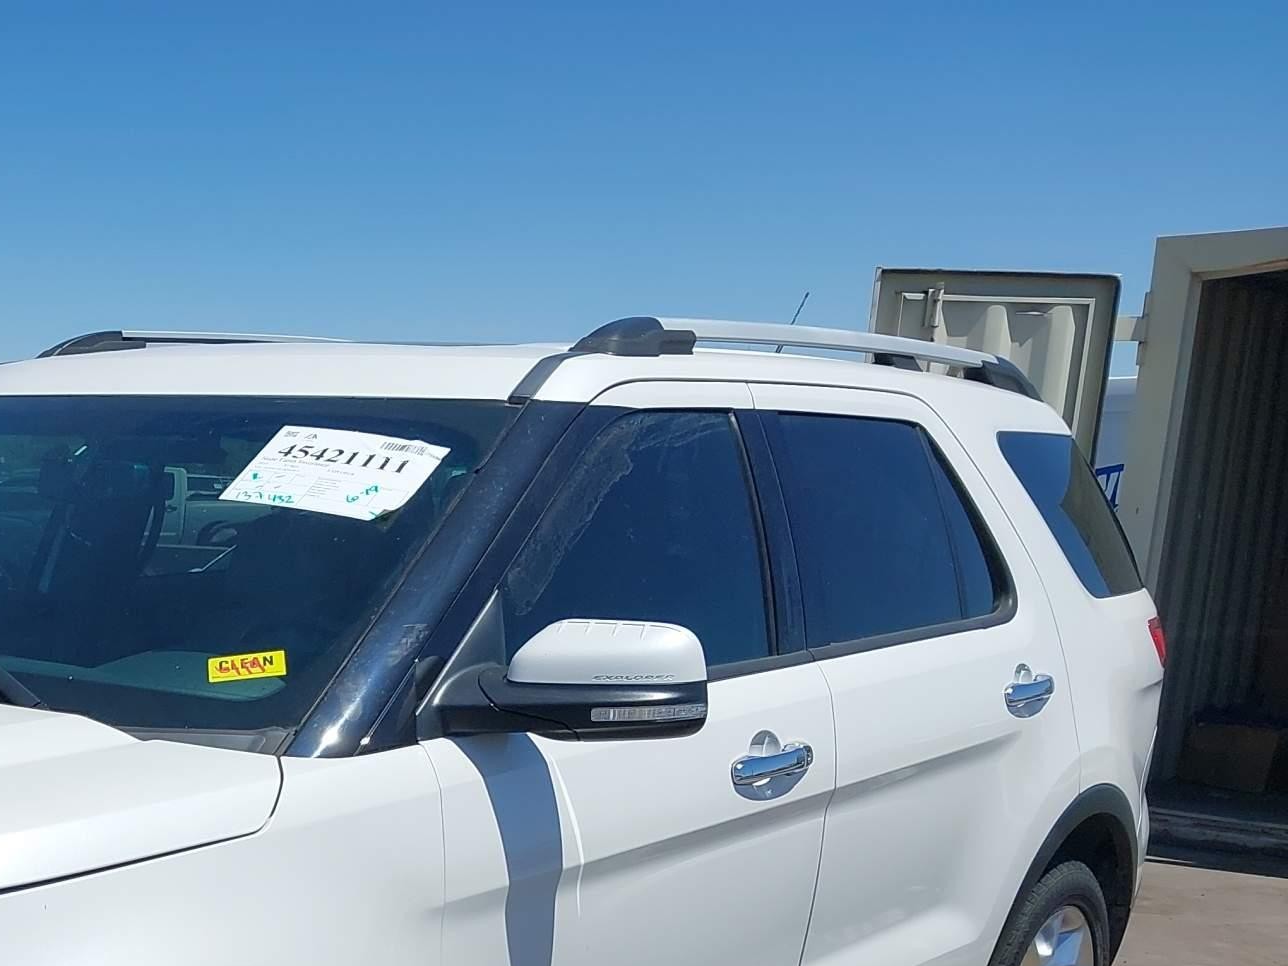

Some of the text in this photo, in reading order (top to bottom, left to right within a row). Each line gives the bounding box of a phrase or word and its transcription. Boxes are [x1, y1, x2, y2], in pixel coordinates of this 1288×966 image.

[278, 443, 409, 474] 45421111
[218, 655, 274, 673] CLEAN
[592, 673, 675, 681] EXPLORER
